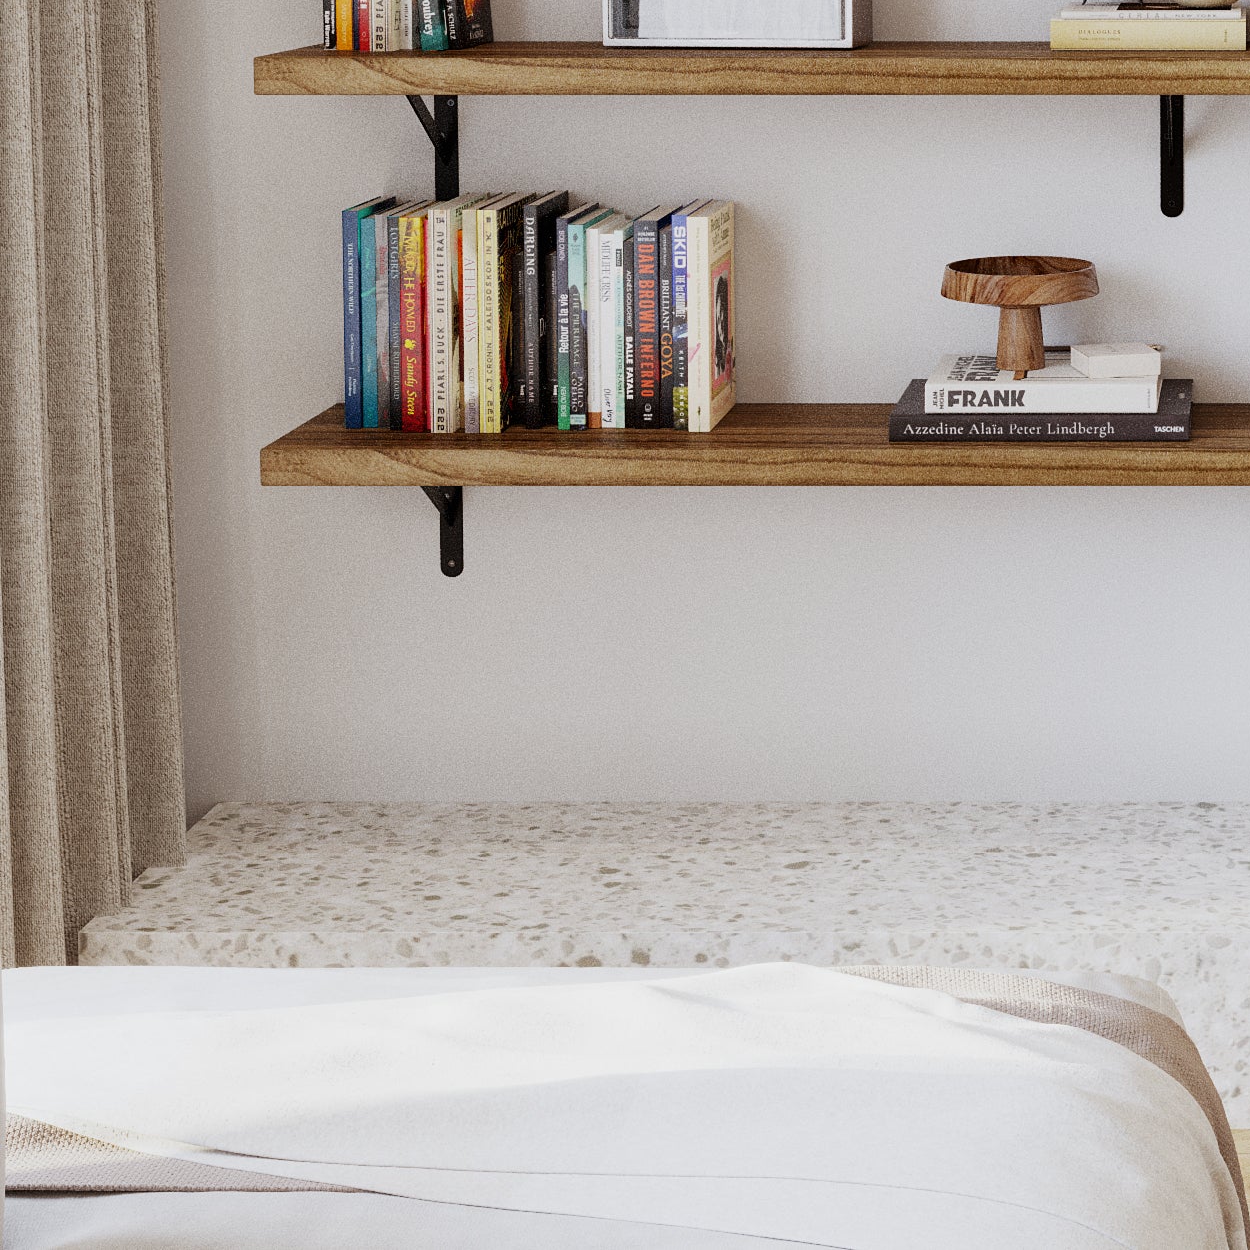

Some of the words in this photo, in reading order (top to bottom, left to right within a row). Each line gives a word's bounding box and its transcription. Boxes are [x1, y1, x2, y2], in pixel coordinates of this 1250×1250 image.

[436, 231, 445, 258] FRAU
[525, 217, 535, 276] DARLING
[638, 243, 655, 275] DAN
[436, 263, 445, 292] ERSTE
[436, 298, 445, 314] DIE
[558, 294, 569, 307] vie
[558, 308, 569, 317] la
[638, 279, 655, 333] BROWN
[661, 279, 669, 331] BRILLIANT
[436, 327, 445, 354] BUCK
[558, 324, 569, 354] Retour
[638, 338, 655, 397] INFERNO
[661, 332, 673, 379] GOYA
[405, 355, 417, 388] Sandy
[436, 372, 445, 401] PEARL
[947, 389, 1026, 407] FRANK
[407, 391, 417, 416] Steen
[903, 423, 965, 435] Azzedine
[969, 423, 1004, 435] Alaïa
[1009, 423, 1044, 435] Peter
[1047, 422, 1115, 437] Lindbergh
